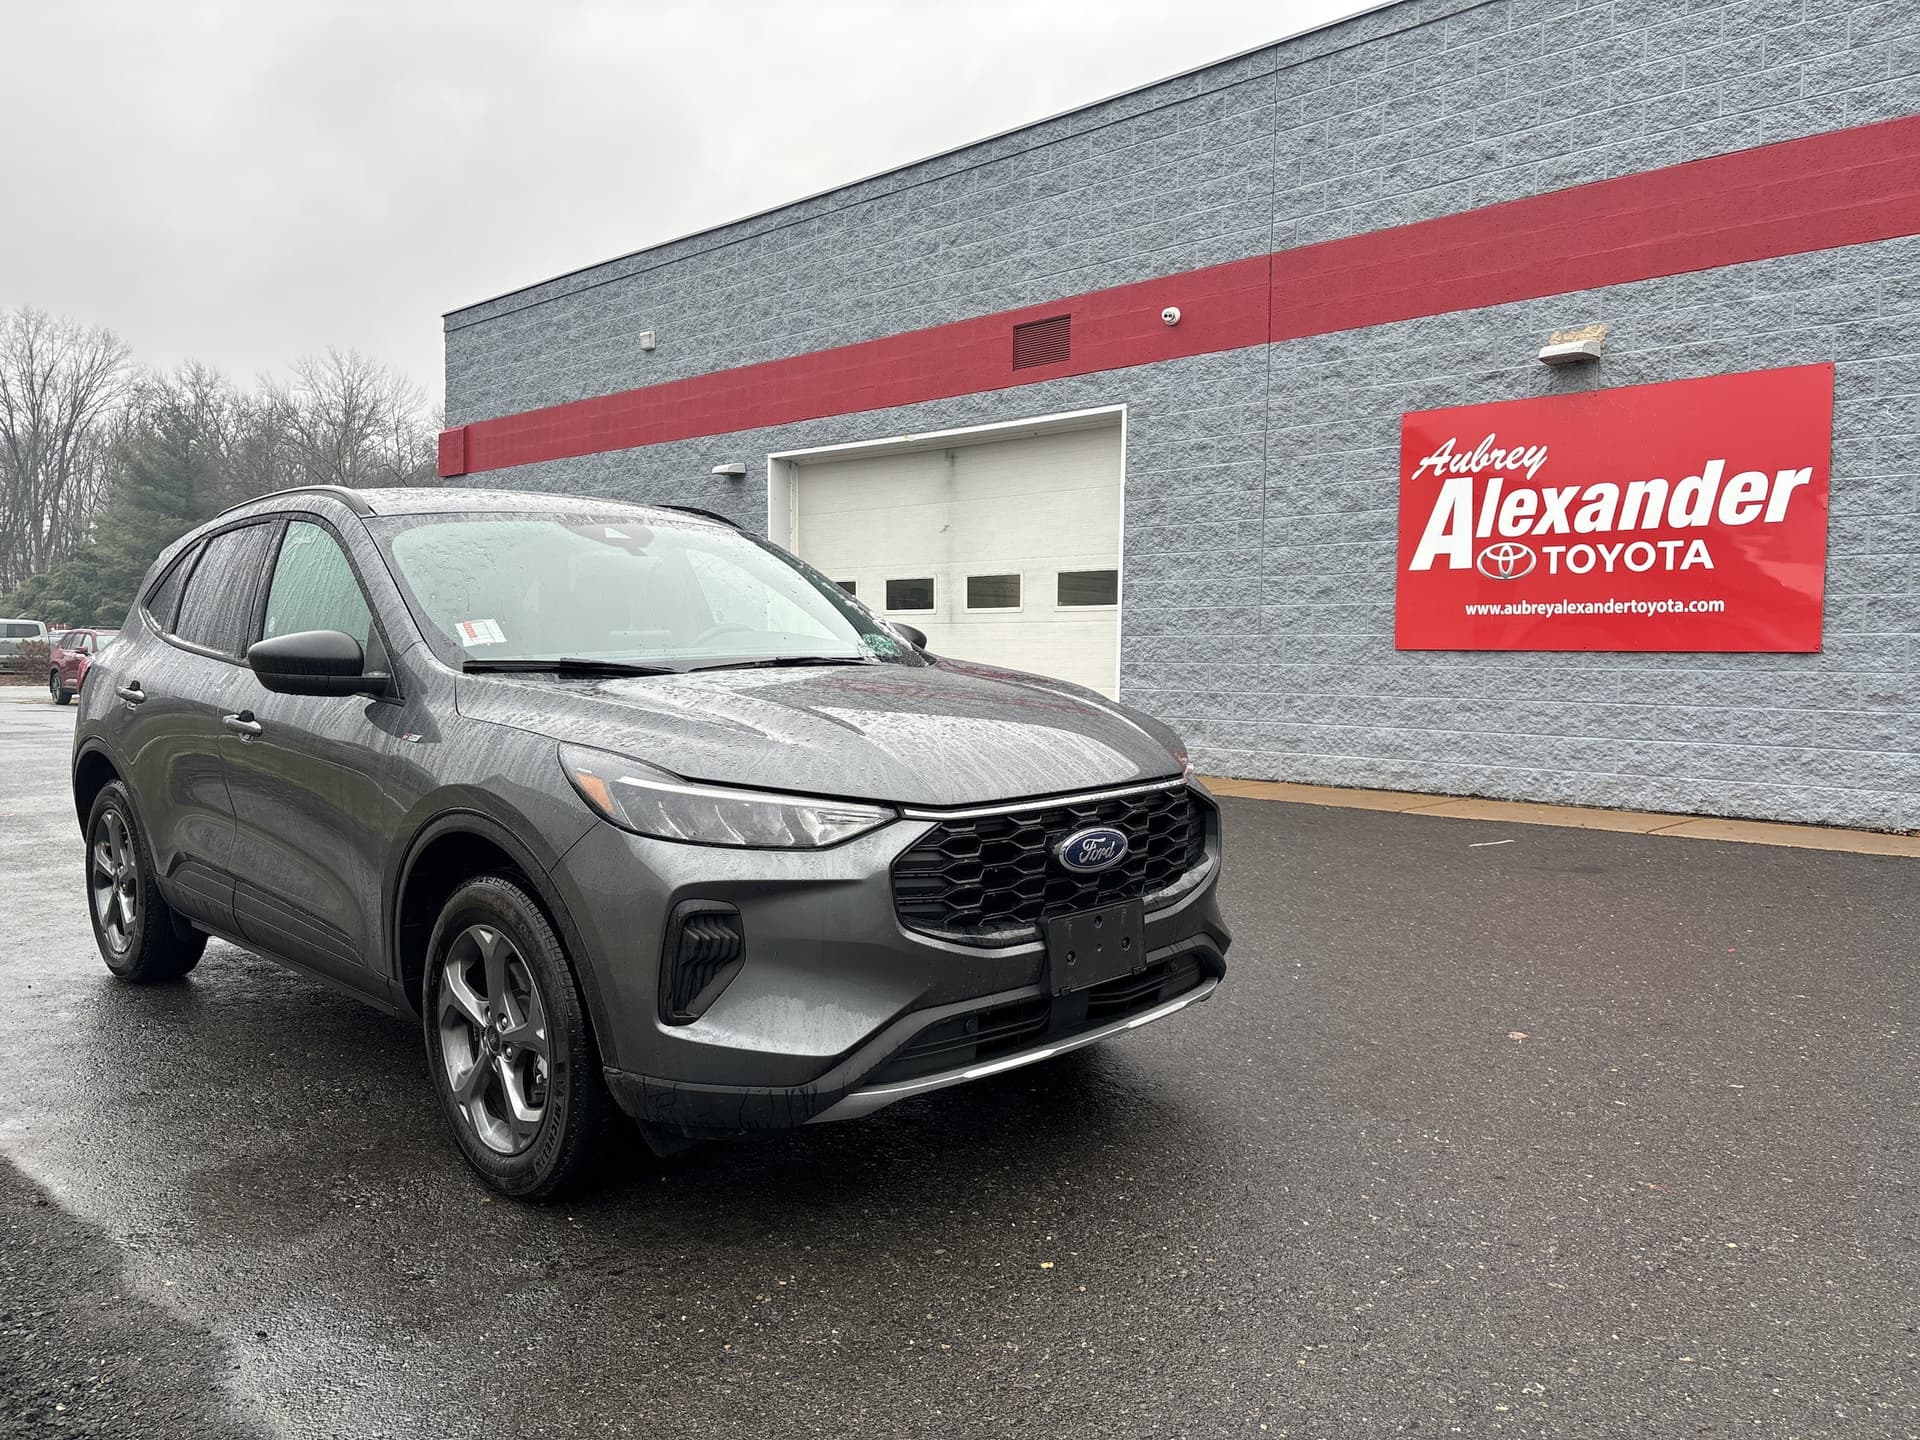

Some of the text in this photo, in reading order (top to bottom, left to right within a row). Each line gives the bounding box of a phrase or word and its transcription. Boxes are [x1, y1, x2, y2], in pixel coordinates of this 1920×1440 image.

[1411, 433, 1547, 480] Aubrey
[1409, 459, 1813, 570] Alexander
[1542, 539, 1714, 574] TOYOTA
[1465, 599, 1725, 618] www.aubreyalexandertoyota.com
[1079, 837, 1115, 863] Ford
[534, 1103, 562, 1176] MICHELIN
